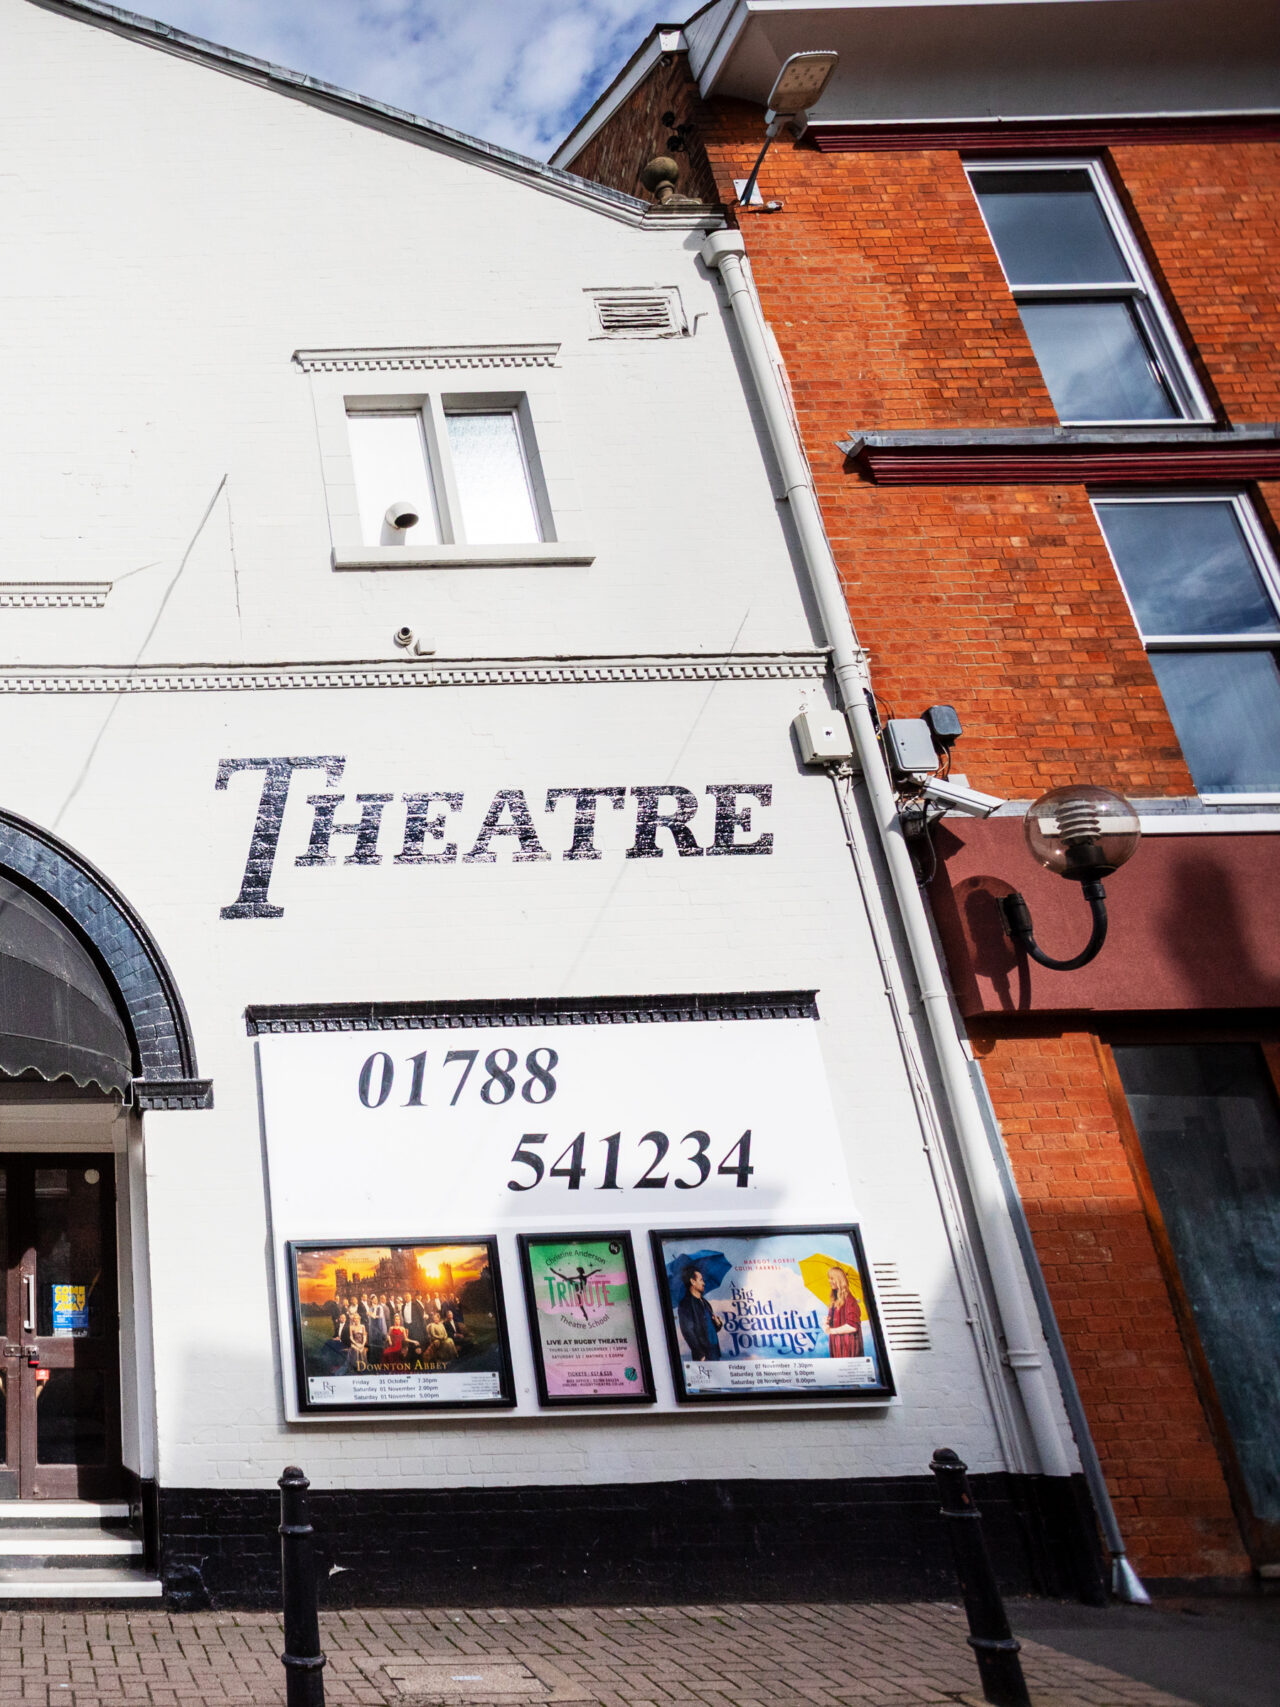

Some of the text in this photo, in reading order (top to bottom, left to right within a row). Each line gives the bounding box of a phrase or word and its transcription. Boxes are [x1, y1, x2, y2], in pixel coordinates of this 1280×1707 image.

[214, 754, 774, 920] THEATRE
[357, 1047, 560, 1109] 01788
[506, 1129, 755, 1191] 541234
[545, 1249, 607, 1267] Christine Anderson
[54, 1285, 86, 1295] COME
[731, 1287, 755, 1303] Big
[53, 1303, 86, 1312] AWAY
[732, 1300, 775, 1317] Bold
[560, 1313, 610, 1329] Theatre School
[722, 1309, 821, 1333] Beautiful
[728, 1331, 821, 1357] Journey
[356, 1359, 449, 1372] DOWNTON ABBEY
